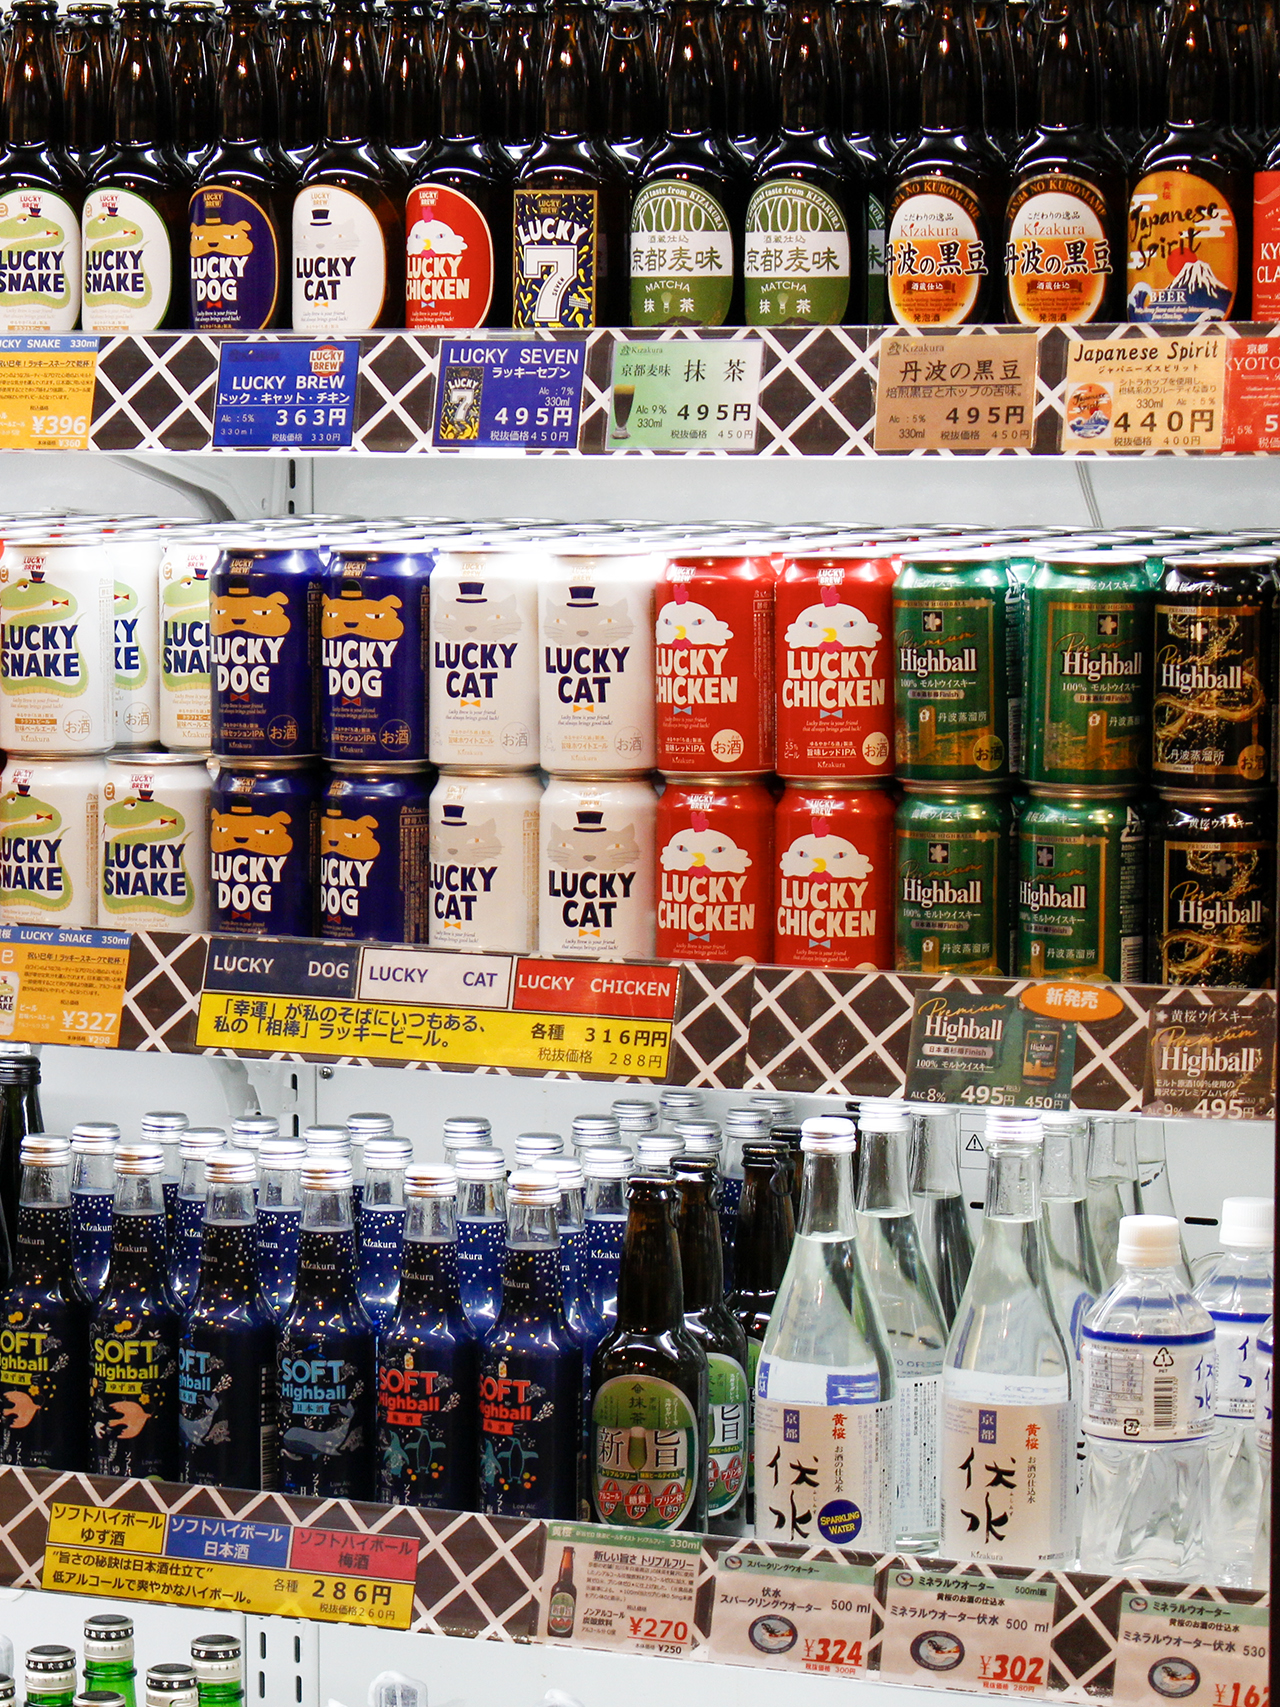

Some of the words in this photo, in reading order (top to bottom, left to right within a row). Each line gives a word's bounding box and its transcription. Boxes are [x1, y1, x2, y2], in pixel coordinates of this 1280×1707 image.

[419, 191, 438, 199] LUCKY
[639, 197, 706, 232] KYOTO
[1130, 200, 1219, 239] Japanese
[517, 218, 588, 245] LUCKY
[1024, 222, 1085, 236] Kizakura
[86, 250, 144, 270] LUCKY
[632, 247, 723, 272] 京都麦味
[1004, 239, 1113, 276] 丹波の黒豆
[1136, 228, 1202, 270] Spirit
[191, 256, 248, 278] LUCKY
[296, 257, 356, 278] LUCKY
[407, 256, 461, 277] LUCKY
[86, 273, 144, 292] SNAKE
[196, 280, 237, 301] DOG
[304, 280, 341, 301] CAT
[523, 245, 577, 322] 7
[552, 276, 565, 297] SEVEN
[645, 280, 690, 292] MATCHA
[761, 281, 807, 293] MATCHA
[1036, 281, 1070, 291] 酒蔵仕込
[1150, 290, 1186, 302] BEER
[1039, 312, 1067, 322] 発泡酒
[27, 340, 60, 348] SNAKE
[70, 339, 97, 348] 330ml
[902, 344, 944, 353] Kizakura
[1074, 344, 1159, 364] Japanese
[1167, 341, 1219, 359] Spirit
[449, 349, 508, 364] LUCKY
[520, 349, 579, 364] SEVEN
[492, 367, 571, 379] ラッキーセブン
[621, 364, 671, 377] 京都麦味
[899, 360, 1021, 383] 丹波の黒豆
[1098, 364, 1199, 374] ジャパニーズスピリット
[233, 376, 285, 390] LUCKY
[296, 375, 345, 389] BREW
[276, 409, 346, 426] 363円
[495, 407, 572, 426] 495円
[677, 404, 751, 422] 495円
[946, 406, 1025, 424] 495円
[1114, 411, 1214, 433] 440円
[33, 416, 86, 435] ¥396
[1, 624, 78, 650] LUCKY
[1, 653, 79, 677] SNAKE
[435, 642, 518, 669] LUCKY
[787, 650, 878, 680] LUCKY
[899, 648, 977, 676] Highball
[446, 672, 498, 699] CAT
[901, 678, 917, 687] 100%
[920, 678, 976, 688] モルトウイスキー
[1161, 665, 1243, 690] Highball
[782, 679, 885, 708] CHICKEN
[807, 748, 856, 756] 旨味レッドIPA
[104, 841, 186, 868] LUCKY
[211, 854, 287, 883] LUCKY
[104, 872, 186, 896] SNAKE
[662, 872, 747, 903] LUCKY
[903, 878, 981, 907] Highball
[218, 884, 272, 911] DOG
[658, 904, 755, 932] CHICKEN
[213, 955, 274, 974] LUCKY
[308, 961, 349, 979] DOG
[369, 965, 428, 983] LUCKY
[463, 971, 497, 987] CAT
[519, 974, 574, 992] LUCKY
[590, 978, 670, 998] CHICKEN
[1046, 988, 1098, 1009] 新発売
[62, 1011, 117, 1031] ¥327
[222, 998, 487, 1033] 「幸運」が私のそばにいつもある、
[1171, 1009, 1252, 1023] 黄桜ウイスキー
[214, 1014, 451, 1048] 私の「相棒」ラッキービール。
[531, 1023, 565, 1041] 各種
[926, 1016, 1002, 1042] Highball
[1160, 1047, 1255, 1073] Highball
[94, 1340, 158, 1363] SOFT
[95, 1363, 158, 1380] Highball
[959, 1447, 1017, 1544] 伏水
[53, 1506, 163, 1530] ソフトハイボール
[820, 1510, 859, 1526] SPARKLING
[828, 1522, 855, 1535] WATER
[203, 1542, 249, 1560] 日本酒
[593, 1551, 637, 1563] 新しい旨さ
[641, 1555, 694, 1568] トリプルフリー
[312, 1579, 392, 1605] 286円
[629, 1617, 688, 1641] ¥270
[804, 1638, 862, 1666] ¥324
[980, 1654, 1045, 1683] ¥302
